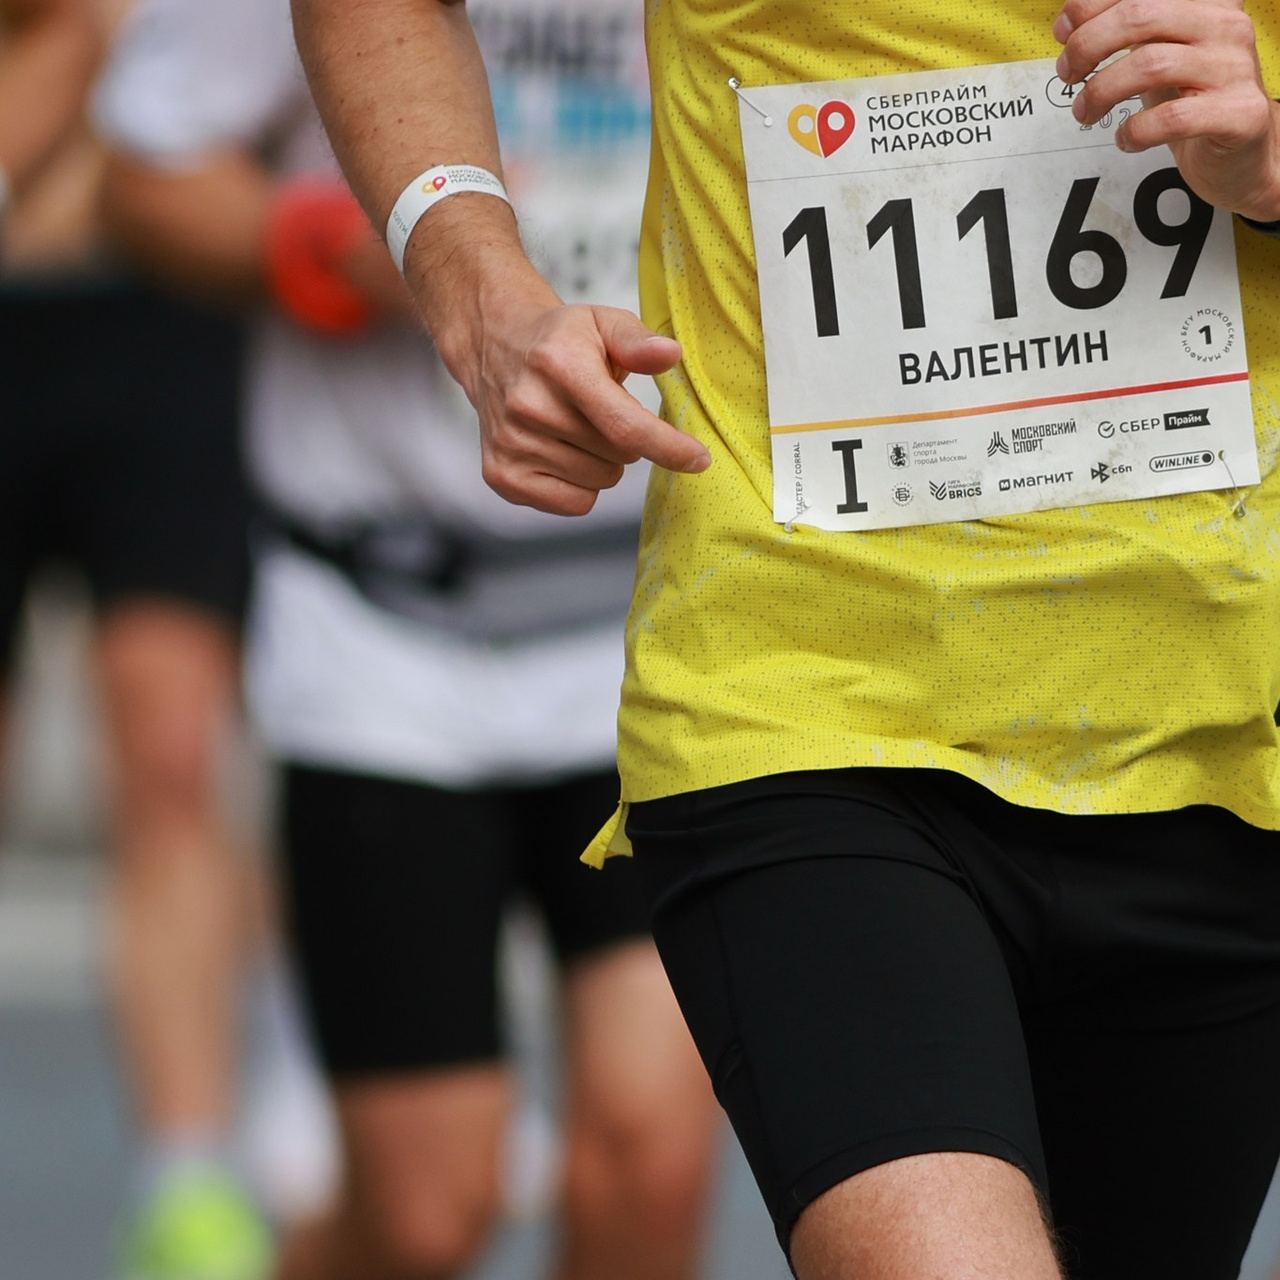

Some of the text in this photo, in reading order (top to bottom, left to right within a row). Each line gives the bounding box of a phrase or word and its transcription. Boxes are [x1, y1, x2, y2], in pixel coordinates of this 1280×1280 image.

[866, 84, 987, 110] СБЕРПРАЙМ
[868, 95, 1034, 132] МОСКОВСКИЙ
[871, 125, 992, 154] МАРАФОН
[782, 166, 1215, 338] 11169
[1198, 325, 1212, 345] 1
[899, 330, 1109, 385] ВАЛЕНТИН
[1012, 419, 1077, 441] МОСКОВСКИЙ
[1119, 414, 1202, 433] СБЕР Прайм
[912, 438, 958, 449] Департамент
[913, 449, 937, 457] спорта
[1013, 439, 1043, 454] СПОРТ
[793, 441, 802, 475] CORRAL
[914, 454, 967, 466] города Москвы
[1154, 455, 1200, 469] WINLINE
[1111, 464, 1132, 474] сбп
[1013, 472, 1073, 488] магнит
[949, 487, 982, 500] BRICS
